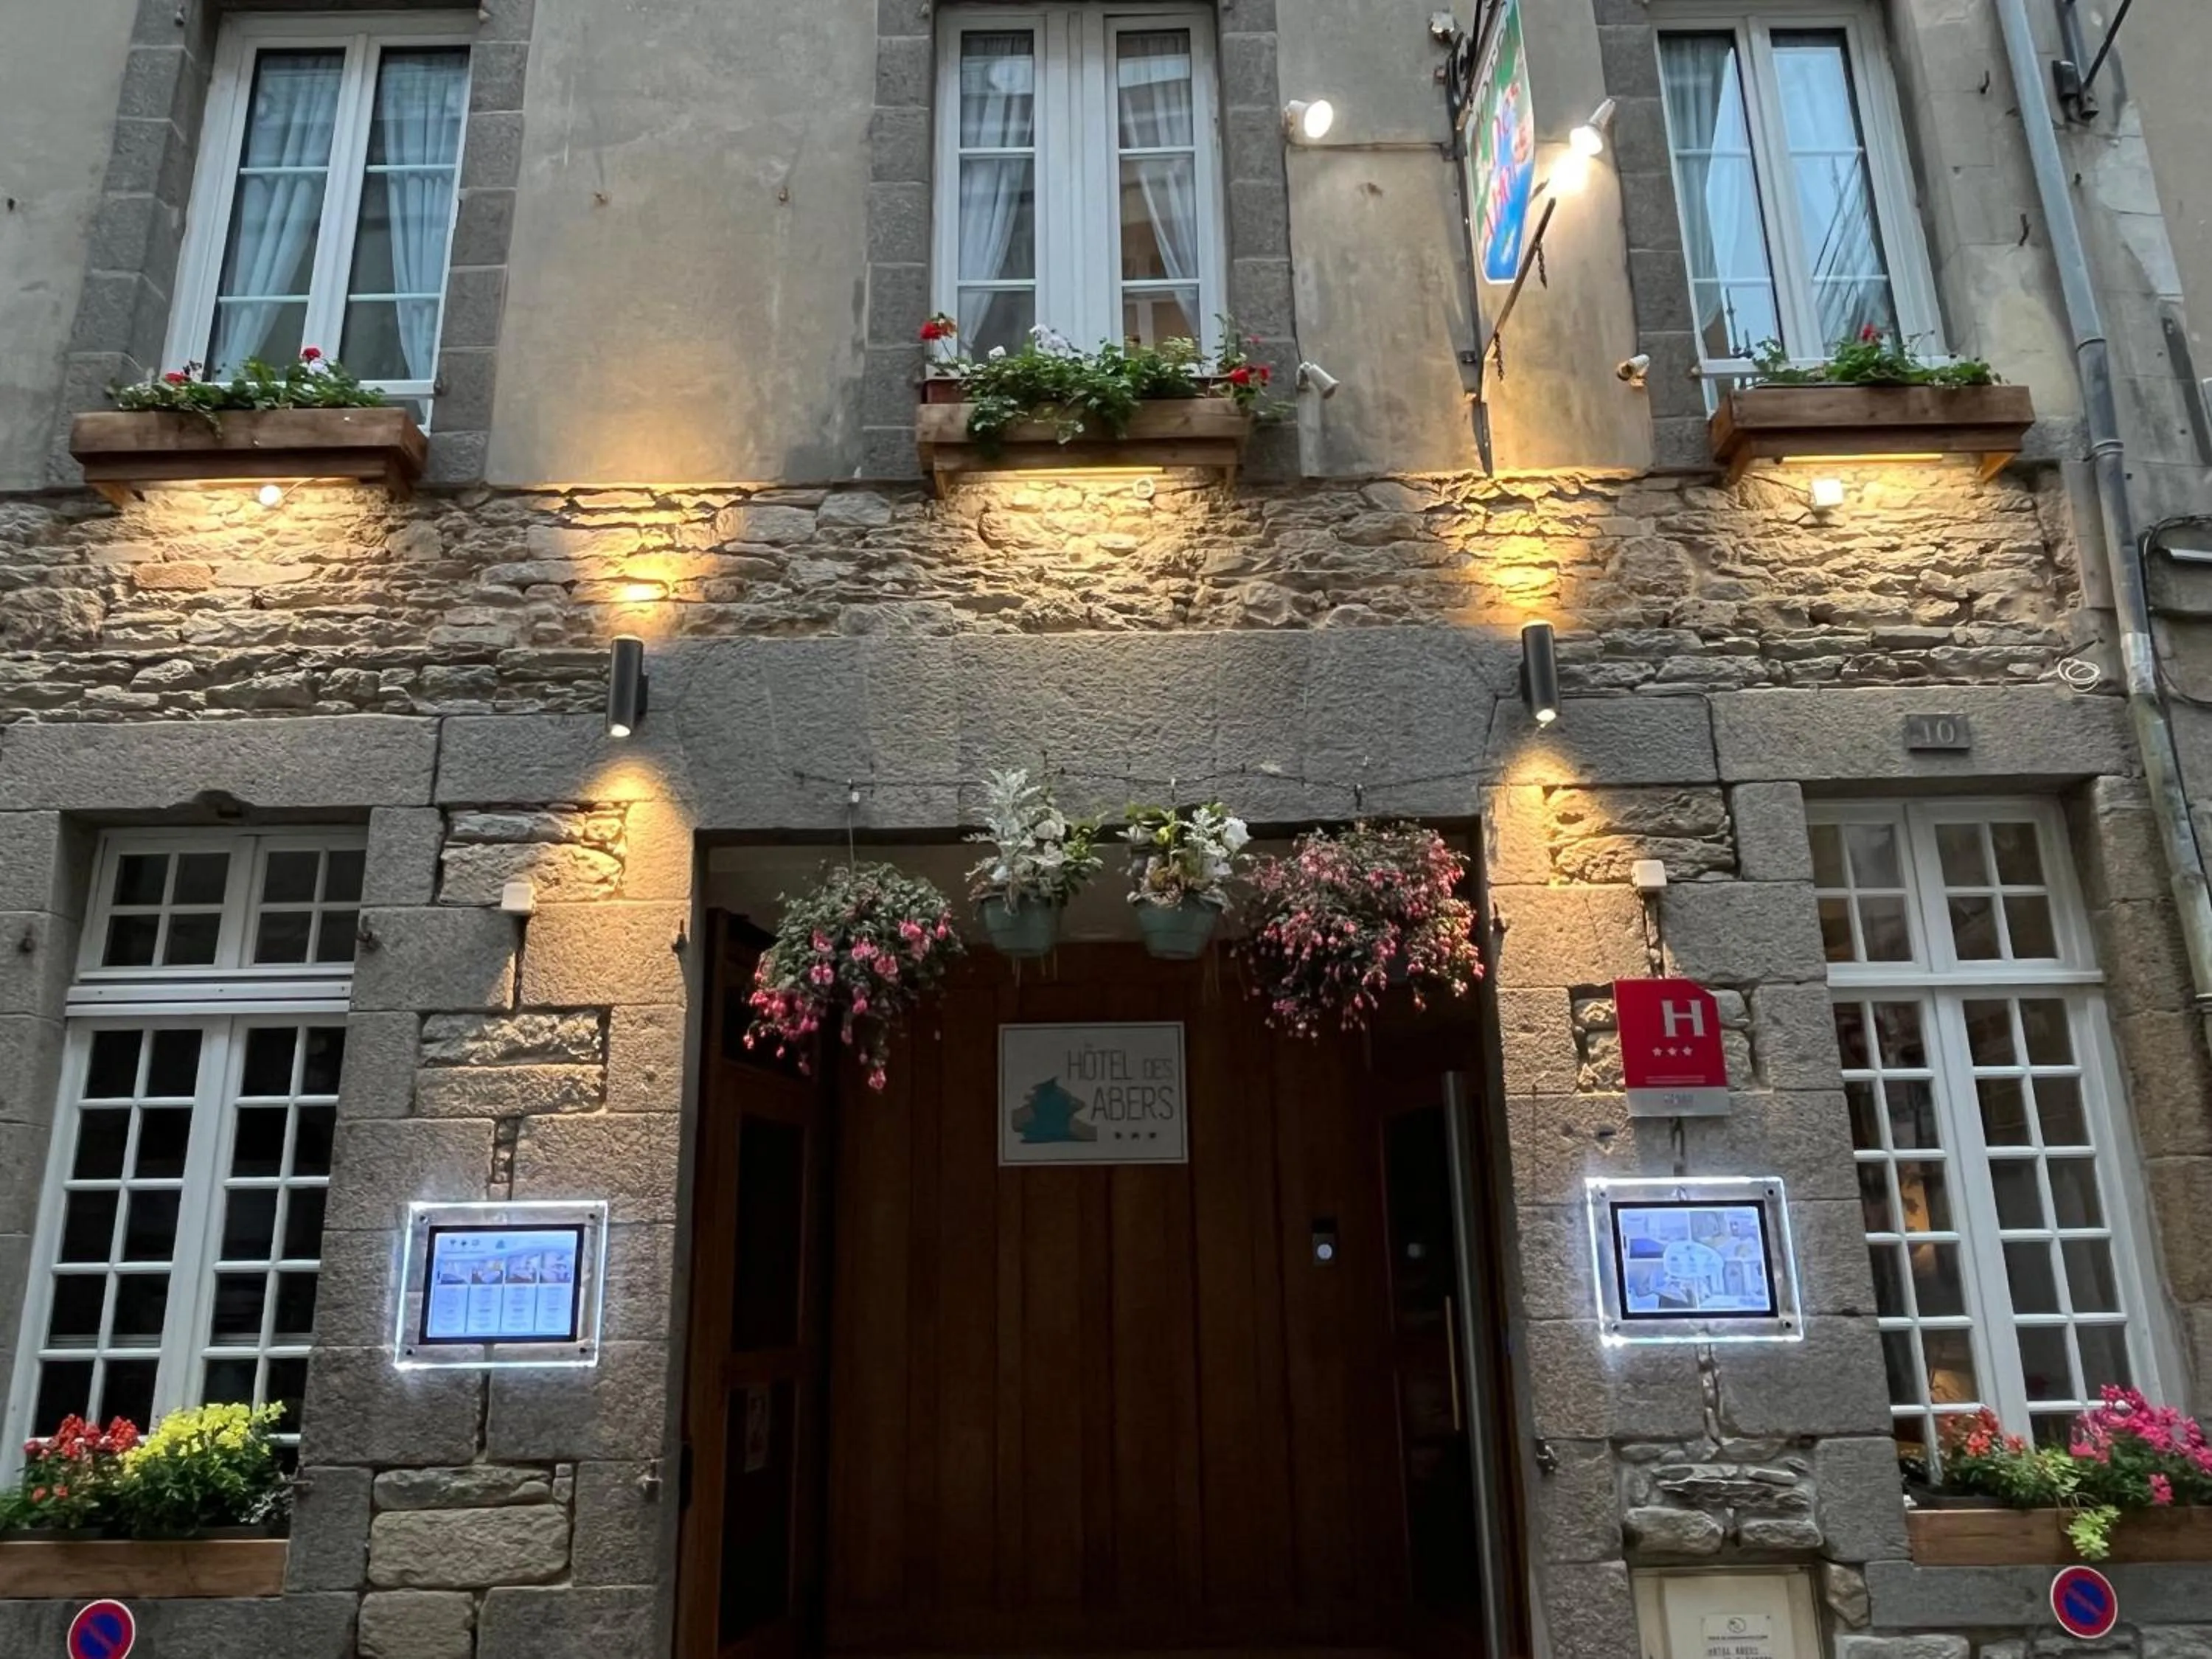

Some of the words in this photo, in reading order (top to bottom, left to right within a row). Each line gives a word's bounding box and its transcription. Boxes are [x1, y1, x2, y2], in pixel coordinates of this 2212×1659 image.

[1921, 720, 1955, 744] 10
[1661, 999, 1707, 1038] H
[1067, 1043, 1133, 1081] HÔTEL
[1143, 1057, 1174, 1080] DES
[1091, 1086, 1175, 1121] ABERS
